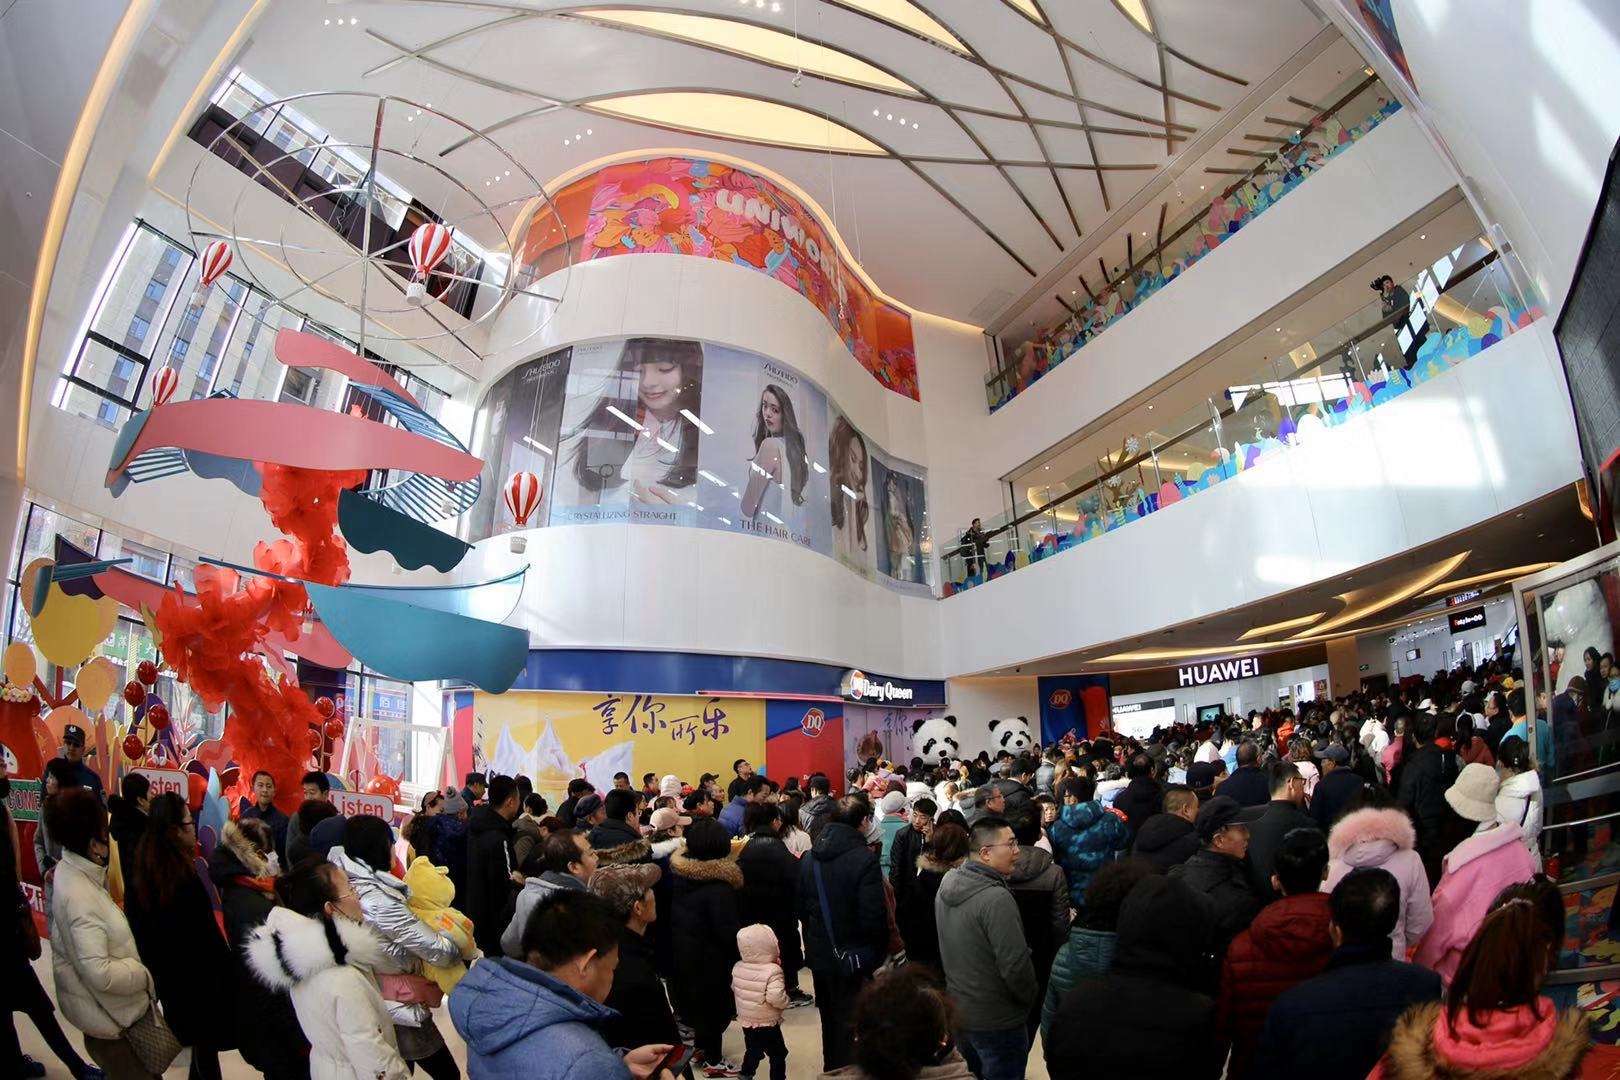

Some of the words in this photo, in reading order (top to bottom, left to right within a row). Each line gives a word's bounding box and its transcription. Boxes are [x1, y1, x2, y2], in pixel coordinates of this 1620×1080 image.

[633, 510, 678, 521] STRAIGHT
[740, 519, 762, 531] THE
[764, 524, 789, 540] HAIR
[1178, 657, 1260, 687] HUAWEI
[863, 679, 885, 702] Dairy
[885, 681, 913, 701] Queen
[592, 693, 731, 746] 享你所乐
[807, 714, 822, 731] DQ
[8, 790, 41, 812] COME
